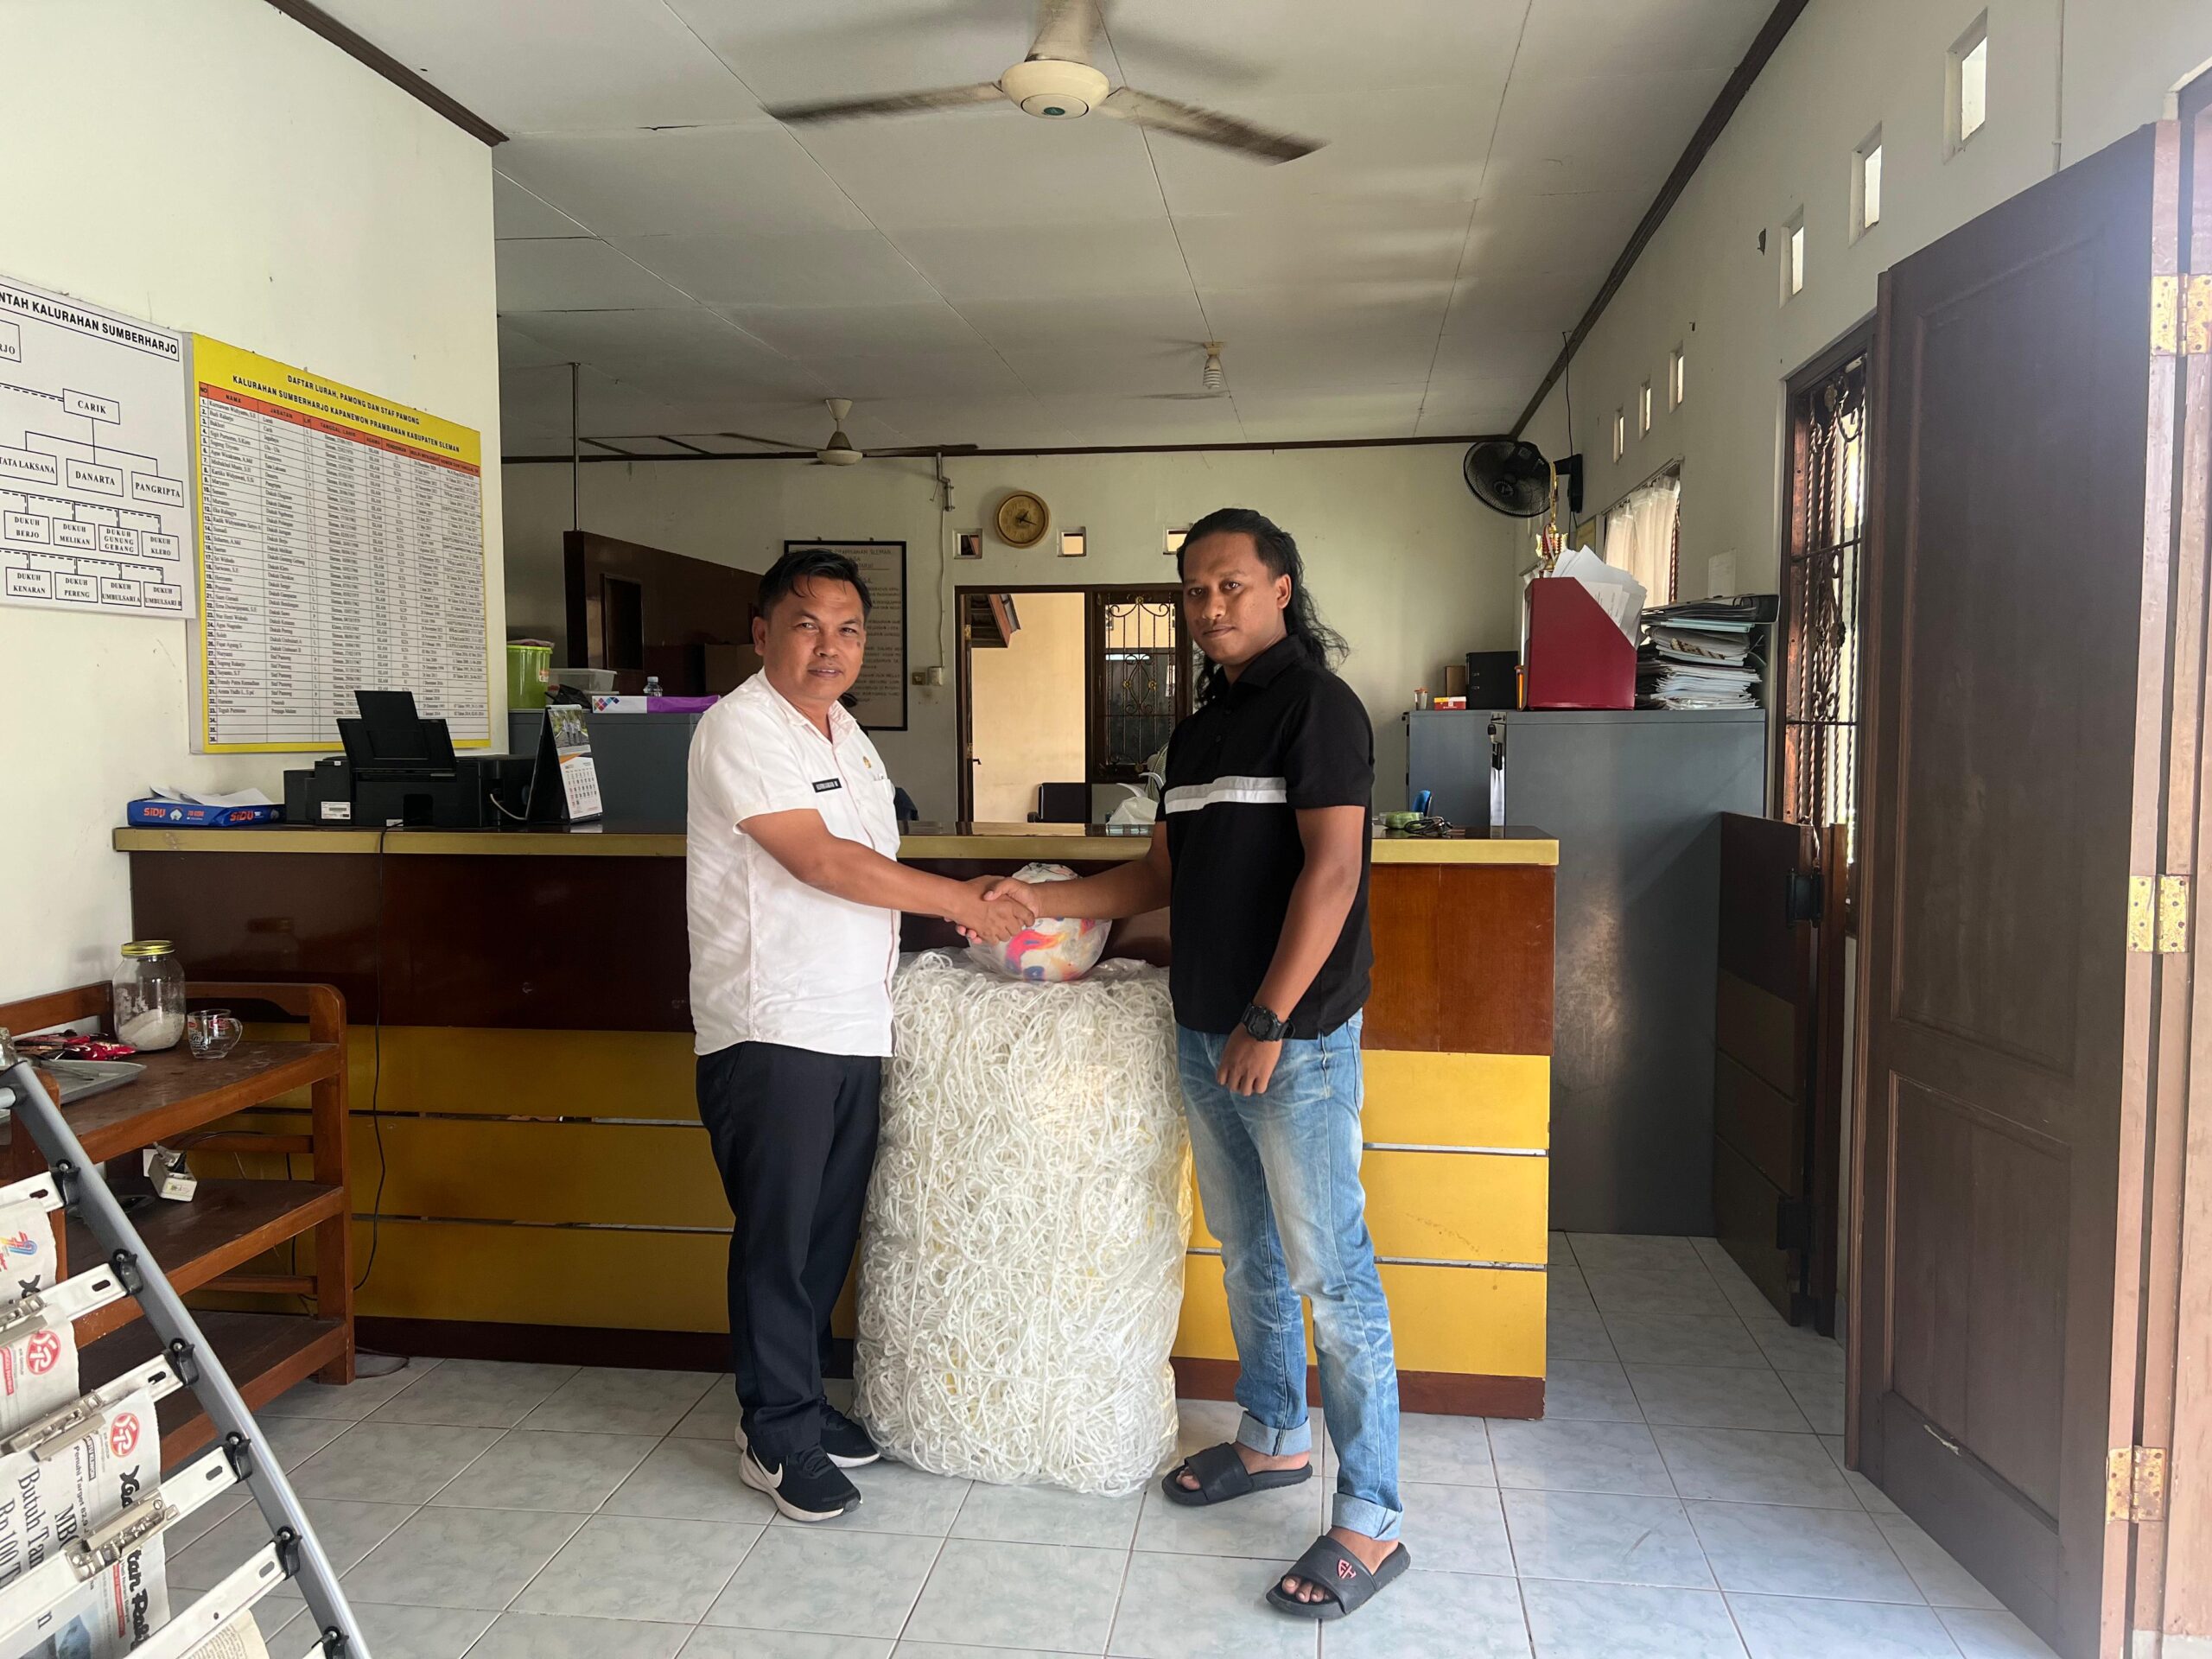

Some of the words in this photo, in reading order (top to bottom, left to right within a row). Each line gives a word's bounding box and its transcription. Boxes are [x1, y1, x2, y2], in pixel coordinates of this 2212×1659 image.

[33, 301, 99, 331] KALURAHAN
[102, 323, 177, 354] SUMBERHARJO
[288, 375, 314, 390] DAFTAR
[315, 385, 339, 399] LURAH,
[340, 393, 366, 407] PAMONG
[367, 403, 379, 412] DAN
[380, 406, 395, 416] STAF
[396, 411, 420, 425] PAMONG
[78, 400, 106, 414] CARIK
[232, 375, 277, 396] KALURAHAN
[279, 390, 329, 412] SUMBERHARJO
[330, 405, 369, 424] KAPANEWON
[370, 420, 406, 436] PRAMBANAN
[407, 429, 438, 446] KABUPATEN
[439, 441, 460, 452] SLEMAN
[19, 461, 55, 474] LAKSANA
[75, 471, 116, 486] DANARTA
[135, 482, 181, 498] PANGRIPTA
[14, 516, 40, 526] DUKUH
[63, 523, 86, 532] DUKUH
[106, 528, 131, 537] DUKUH
[16, 530, 39, 538] BERJO
[60, 536, 91, 545] MELIKAN
[104, 536, 134, 545] GUNUNG
[149, 536, 171, 545] DUKUH
[105, 543, 134, 553] GEBANG
[16, 572, 41, 581] DUKUH
[13, 585, 46, 594] KENARAN
[64, 589, 90, 598] PERENG
[18, 1467, 47, 1533] Butuh
